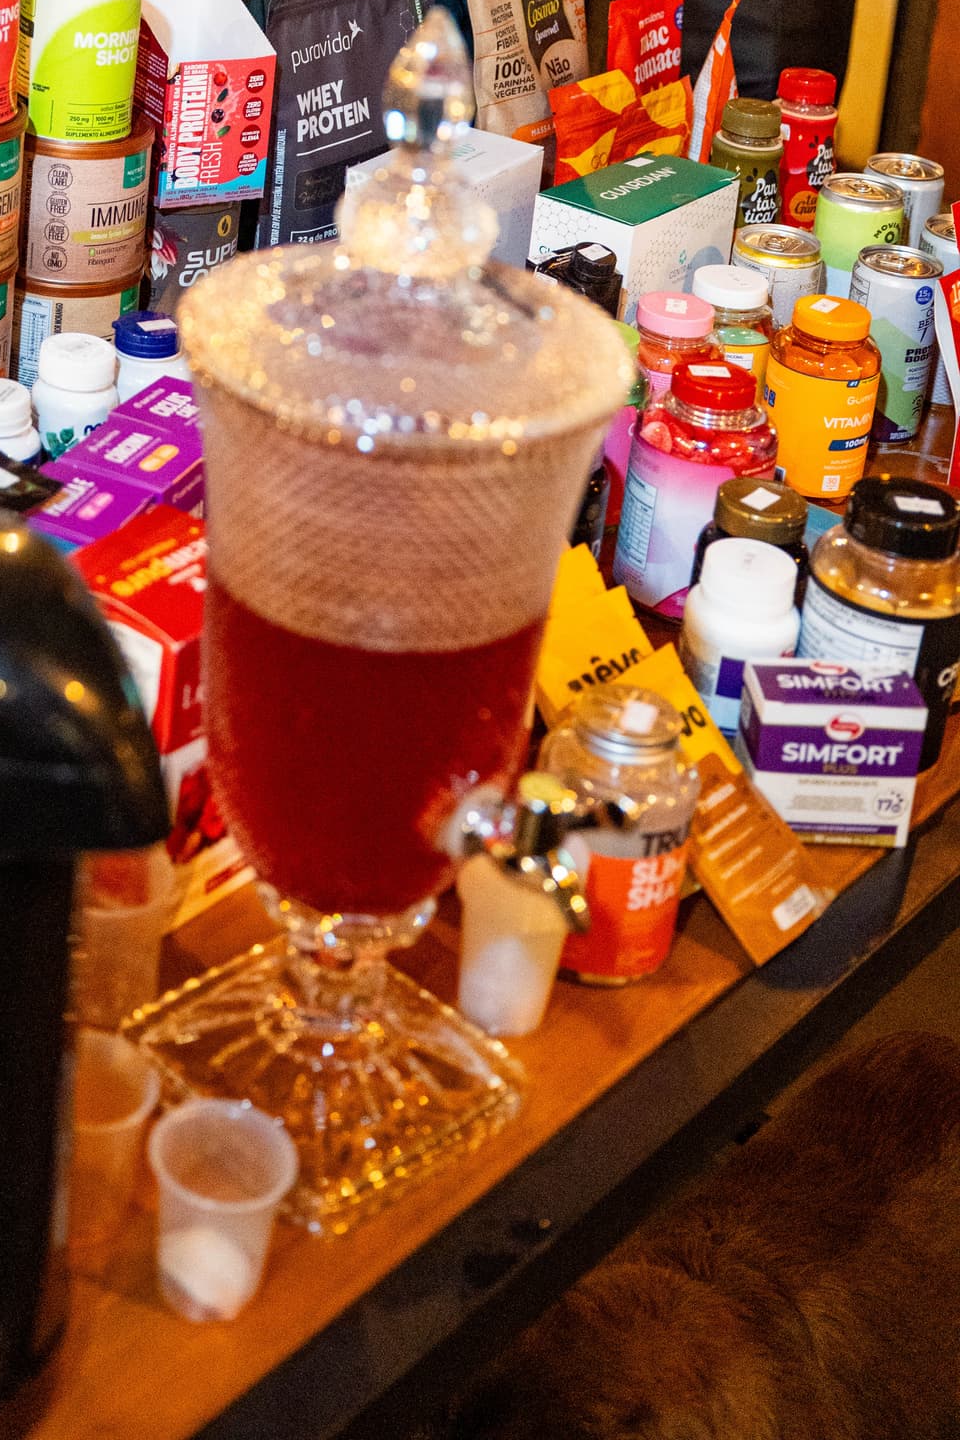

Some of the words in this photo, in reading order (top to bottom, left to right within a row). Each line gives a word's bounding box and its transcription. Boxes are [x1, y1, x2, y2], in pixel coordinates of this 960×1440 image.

[291, 31, 352, 73] puravida
[496, 32, 520, 51] FIBRAS
[95, 46, 137, 66] SHOT
[634, 47, 681, 85] tomate
[175, 74, 182, 85] PÓ
[495, 57, 532, 81] 100%
[545, 58, 570, 80] Não
[493, 74, 535, 91] FARINHAS
[494, 82, 536, 99] VEGETAIS
[178, 74, 208, 142] PROTEIN
[297, 79, 344, 116] WHEY
[171, 101, 180, 141] ALIMENTAR
[297, 98, 371, 143] PROTEIN
[166, 142, 176, 190] SUPLEMENTO
[200, 142, 222, 187] FRESH
[814, 144, 833, 166] Pan
[52, 170, 68, 178] CLEAN
[173, 147, 202, 189] BODY
[52, 178, 68, 186] LABEL
[599, 167, 673, 201] GUARDIAN
[751, 178, 778, 202] Pan
[50, 206, 66, 214] FREE
[91, 194, 146, 228] IMMUNE
[756, 196, 776, 212] tás
[744, 208, 778, 224] tica
[48, 232, 64, 241] FREE
[776, 674, 895, 693] SIMFORT
[781, 742, 902, 766] SIMFORT
